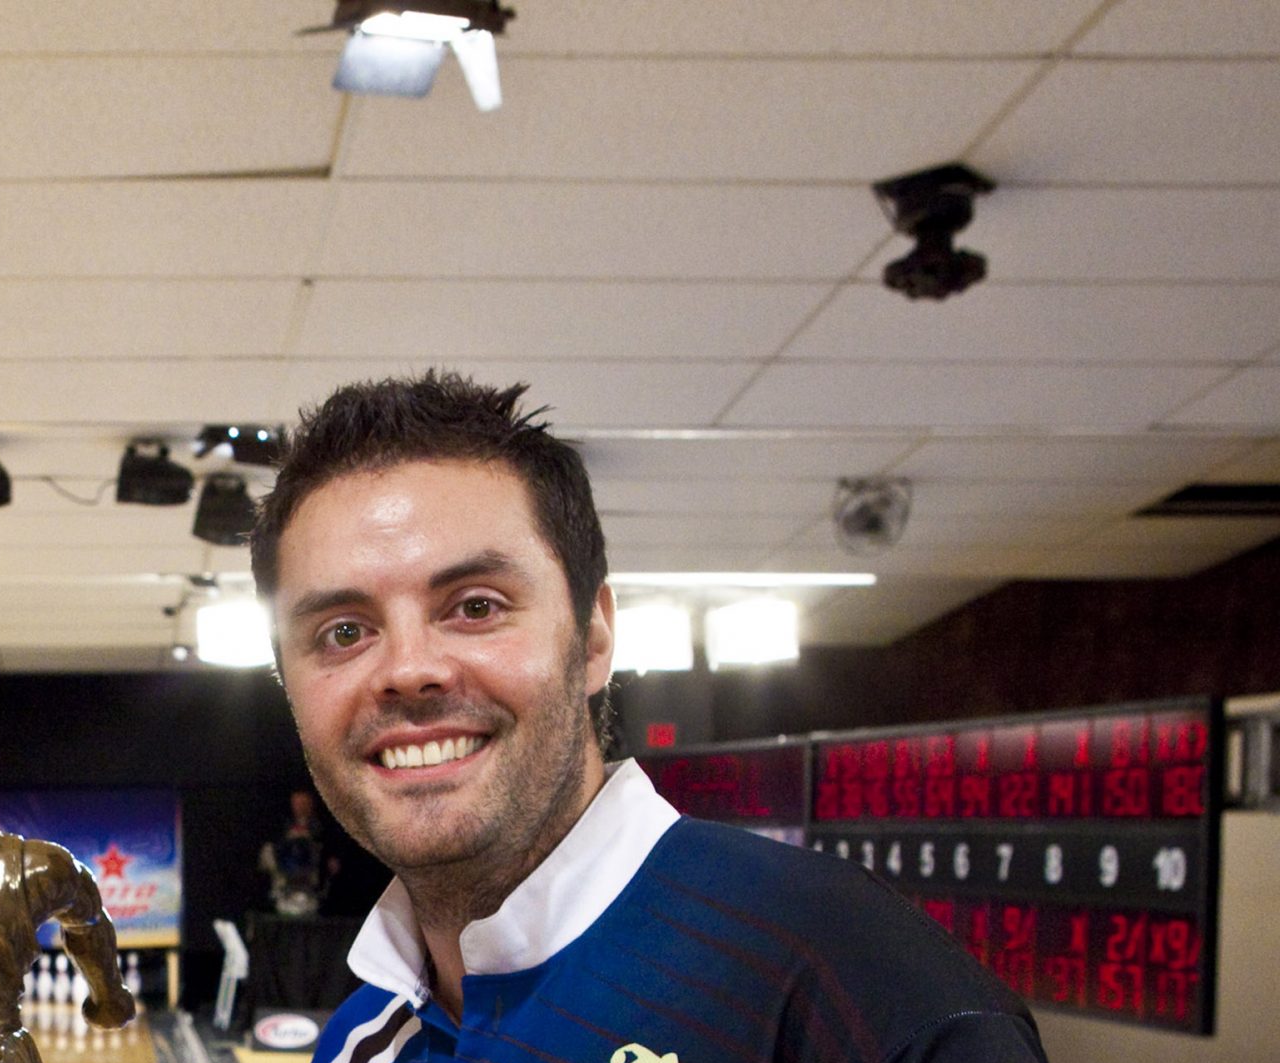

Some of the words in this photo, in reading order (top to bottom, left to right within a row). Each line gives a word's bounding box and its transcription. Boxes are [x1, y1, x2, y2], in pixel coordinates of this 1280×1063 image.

[886, 840, 902, 876] 4
[920, 841, 935, 878] 5
[953, 842, 969, 880] 6
[996, 843, 1013, 881] 7
[1044, 843, 1063, 885] 8
[1099, 845, 1119, 888] 9
[1152, 847, 1187, 891] 10
